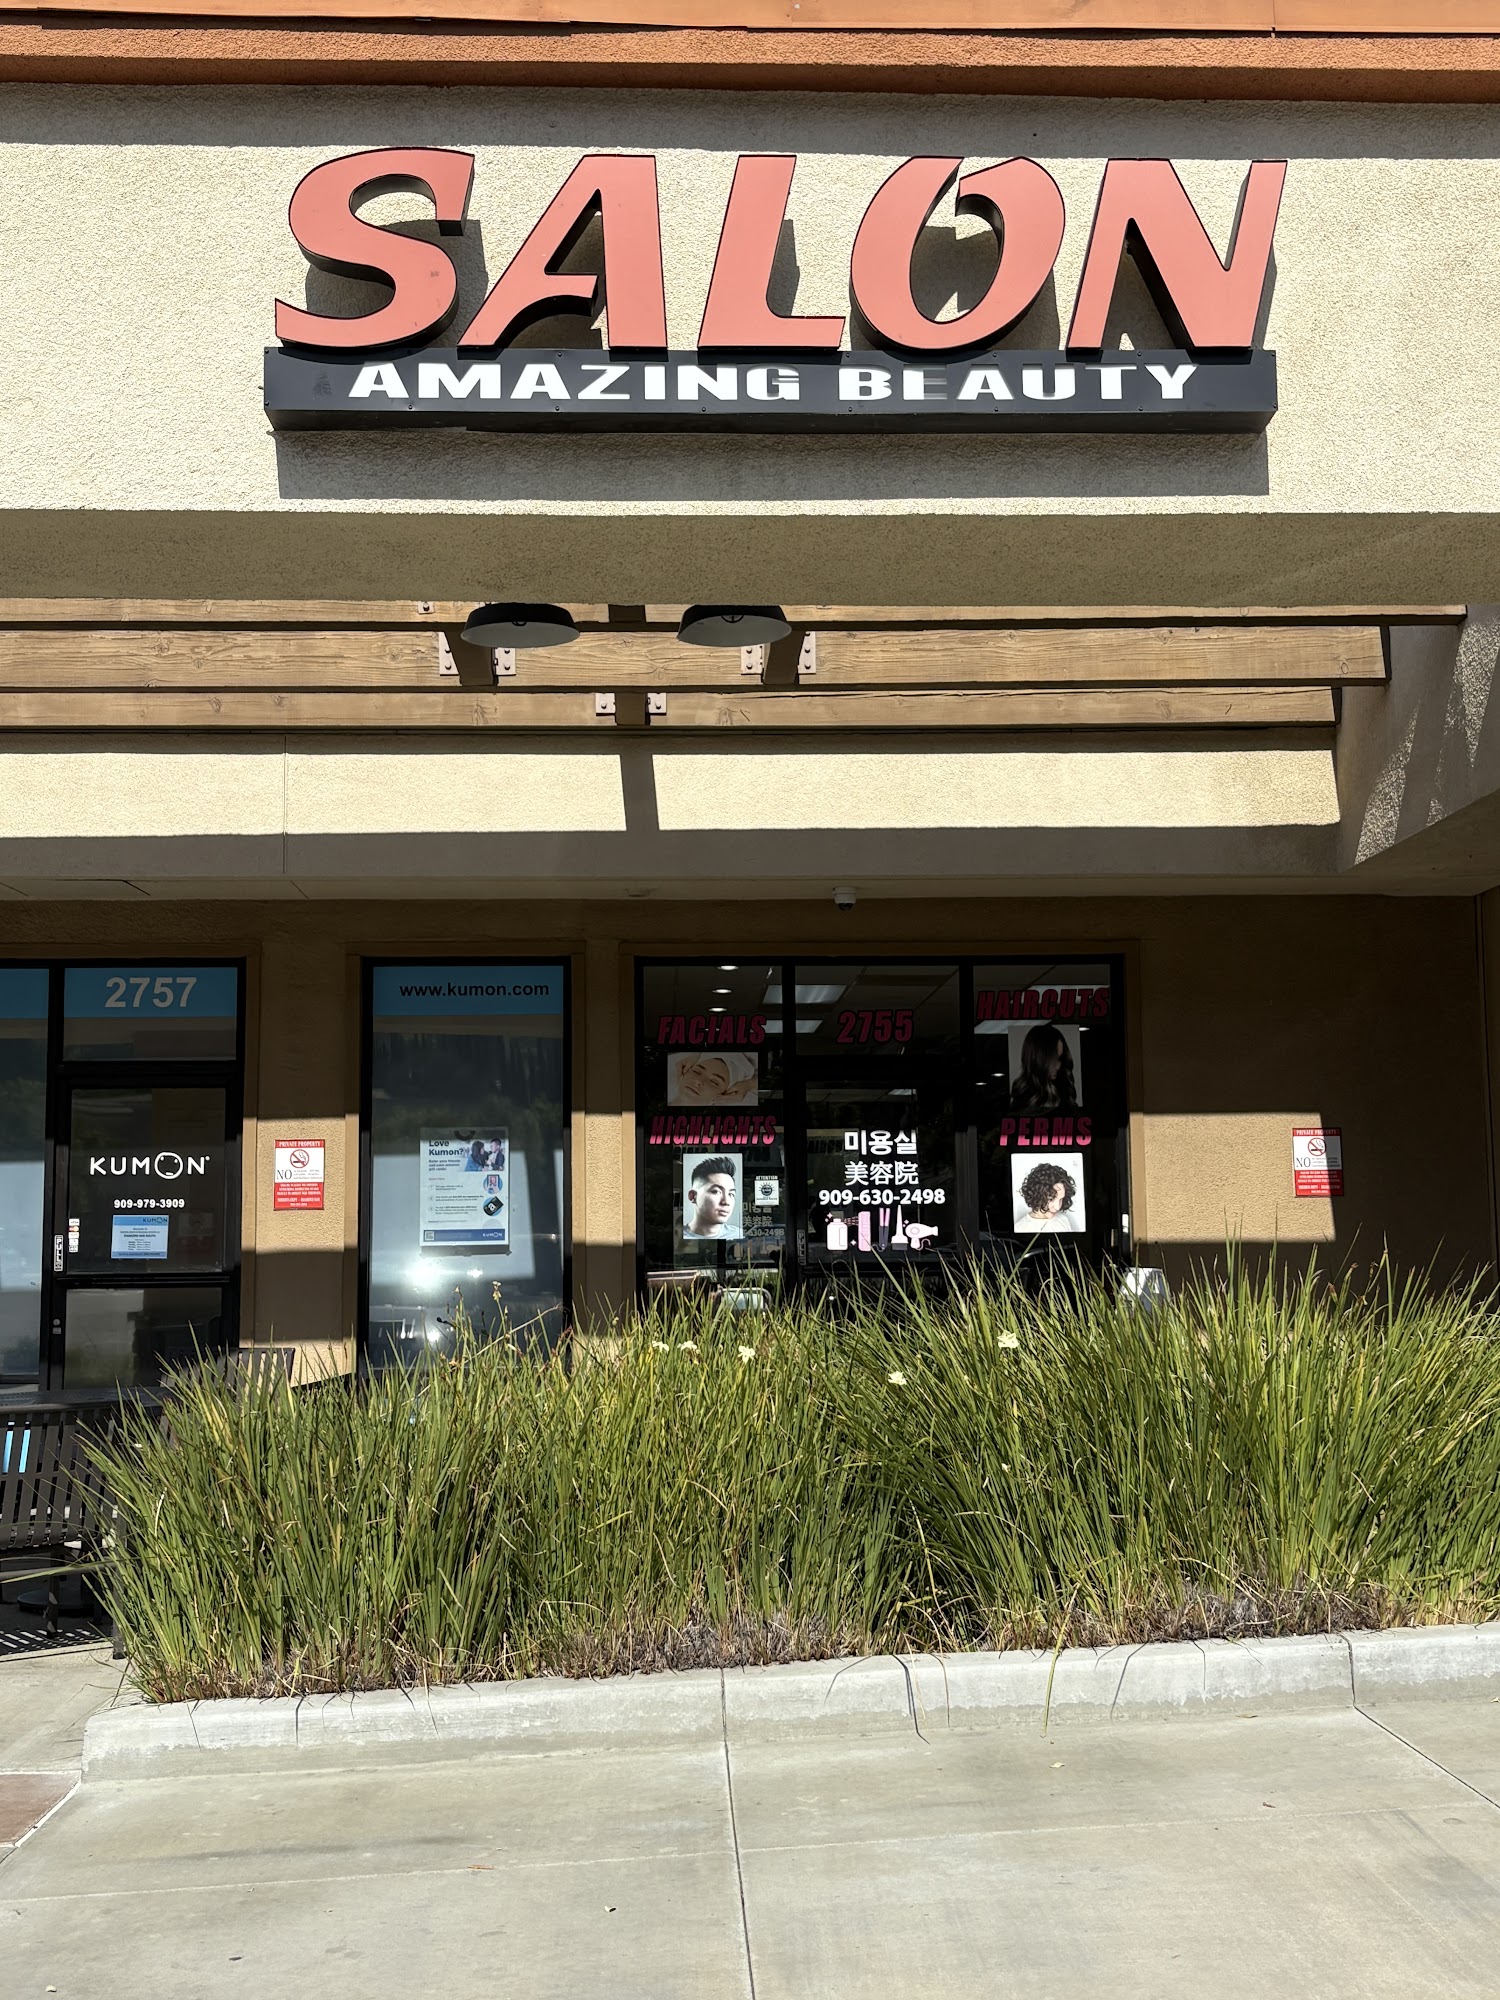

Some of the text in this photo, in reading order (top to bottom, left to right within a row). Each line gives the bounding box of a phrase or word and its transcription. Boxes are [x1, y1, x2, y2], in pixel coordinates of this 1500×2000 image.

[275, 146, 1286, 350] SALON
[348, 361, 1198, 402] AMAZING BEAUTY
[104, 976, 197, 1009] 2757
[399, 981, 550, 998] www.kumon.com
[976, 987, 1110, 1020] HAIRCUTS
[657, 1014, 767, 1047] FACIALS
[836, 1009, 915, 1045] 2755
[428, 1139, 449, 1147] Love
[648, 1113, 778, 1146] HIGHLIGHTS
[843, 1129, 918, 1156] 미용실
[998, 1114, 1094, 1148] PERMS
[89, 1151, 206, 1181] KUMON
[428, 1148, 464, 1157] Kumon?
[1296, 1157, 1311, 1168] NO
[276, 1169, 293, 1180] NO
[843, 1160, 920, 1186] 美容院
[113, 1198, 185, 1209] 909-979-3909
[818, 1187, 946, 1206] 909-630-2498
[142, 1216, 168, 1224] KUMON
